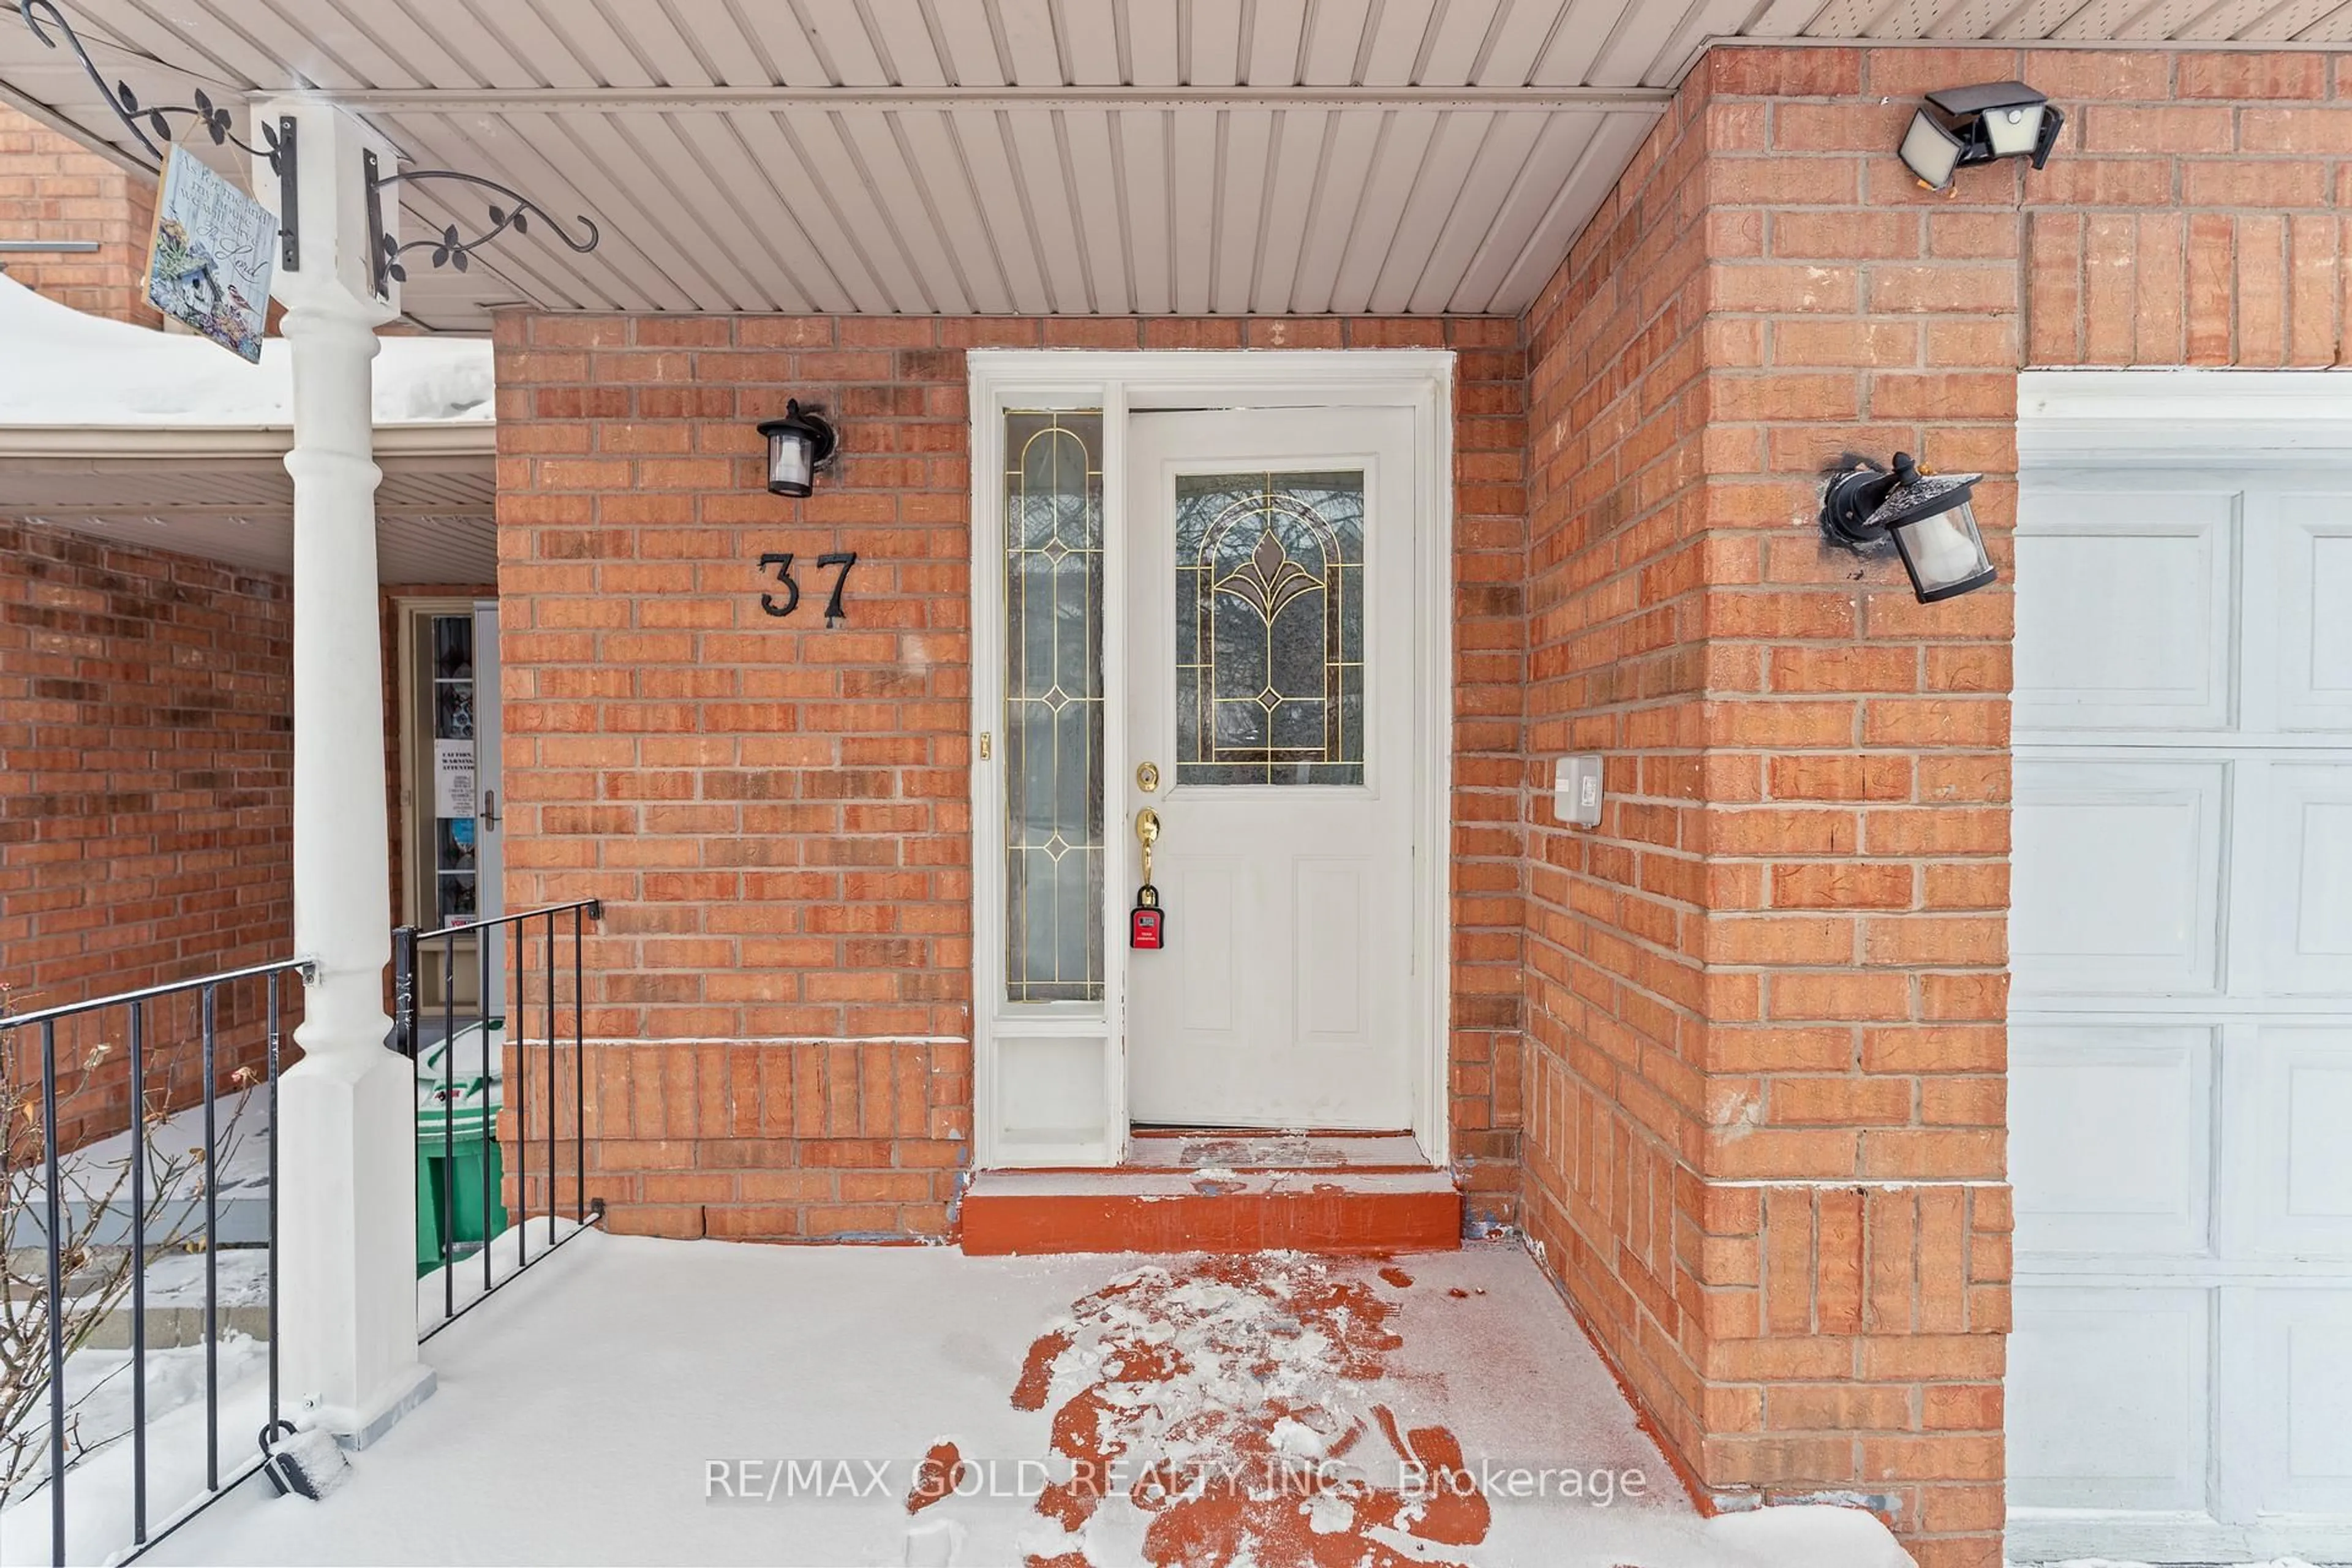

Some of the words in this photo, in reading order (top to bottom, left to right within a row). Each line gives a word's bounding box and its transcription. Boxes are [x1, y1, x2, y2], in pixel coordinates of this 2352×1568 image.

[180, 156, 197, 175] As
[222, 187, 243, 207] me
[245, 205, 267, 225] and
[181, 187, 200, 206] we
[202, 202, 224, 224] will
[227, 221, 258, 246] serve
[191, 181, 213, 201] my
[215, 193, 252, 228] house
[214, 238, 268, 284] Lord
[760, 552, 858, 620] 37
